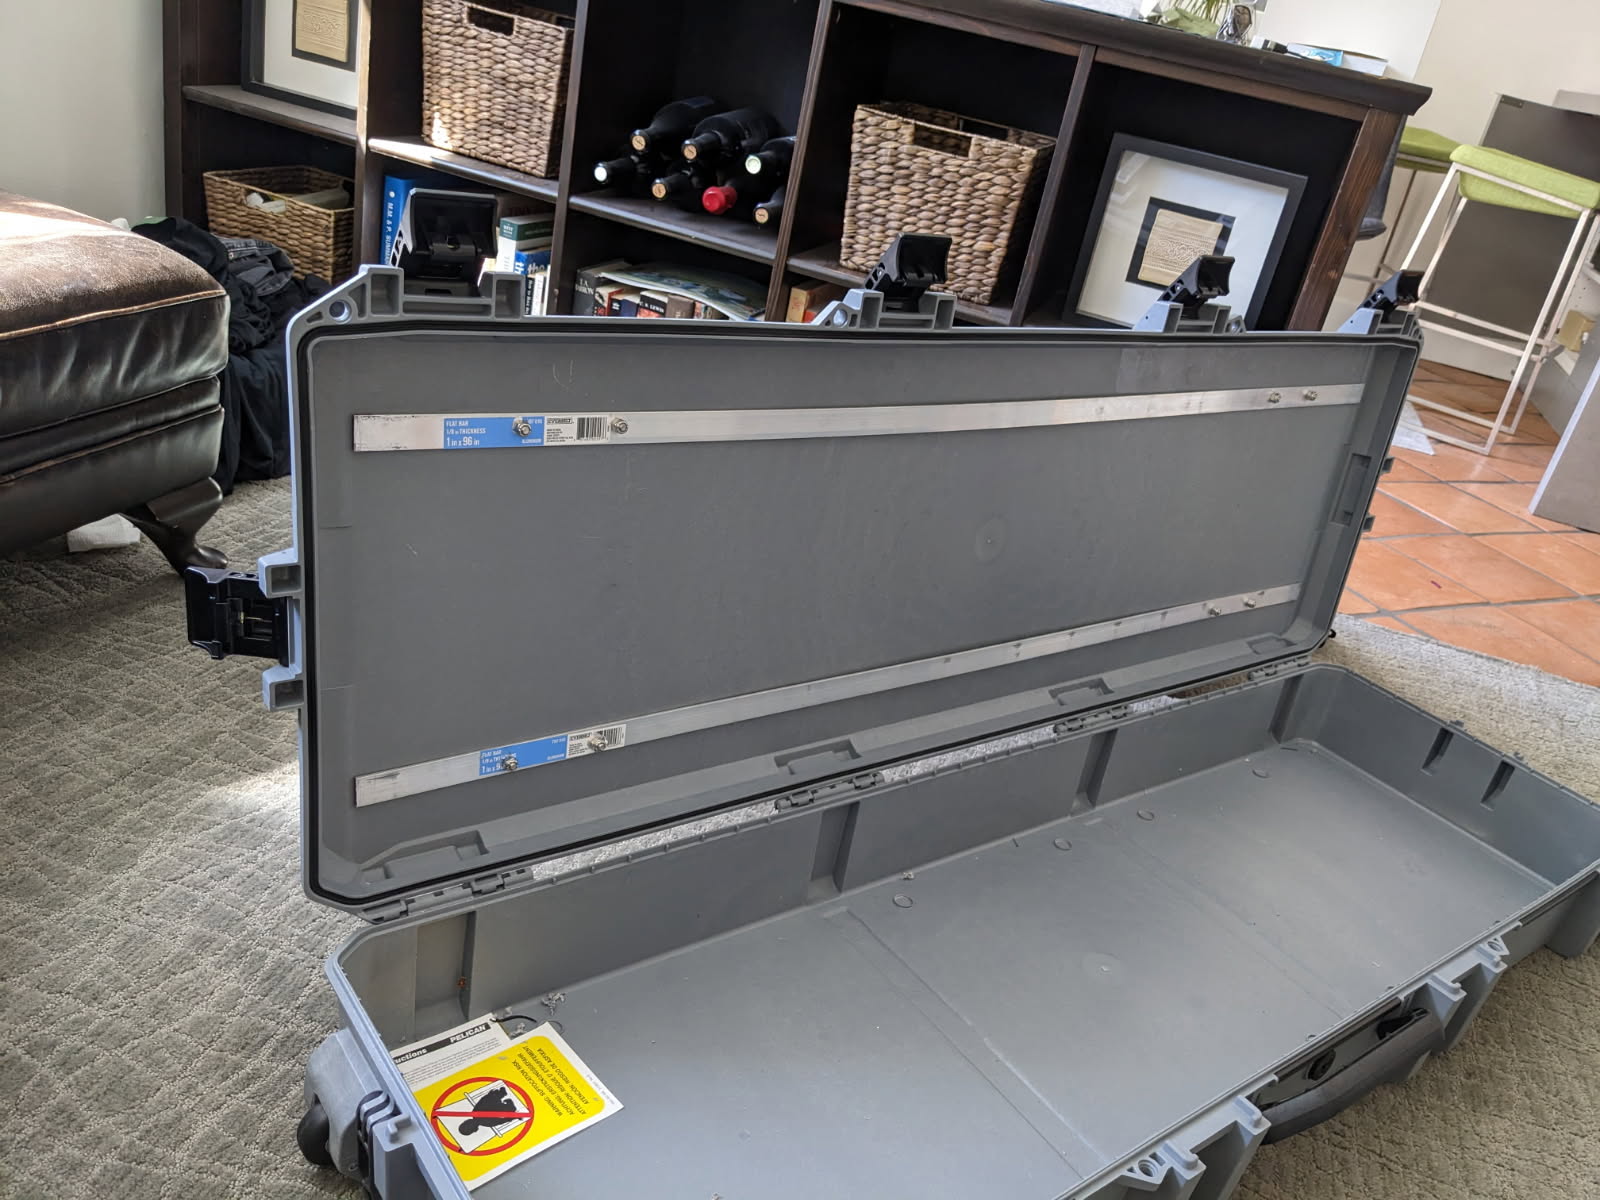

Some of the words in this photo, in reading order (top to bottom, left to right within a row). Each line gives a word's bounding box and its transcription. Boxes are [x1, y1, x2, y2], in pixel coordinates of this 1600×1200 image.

[451, 438, 457, 446] in
[463, 436, 472, 446] 96
[473, 438, 480, 446] in
[449, 1024, 486, 1044] PELICAN
